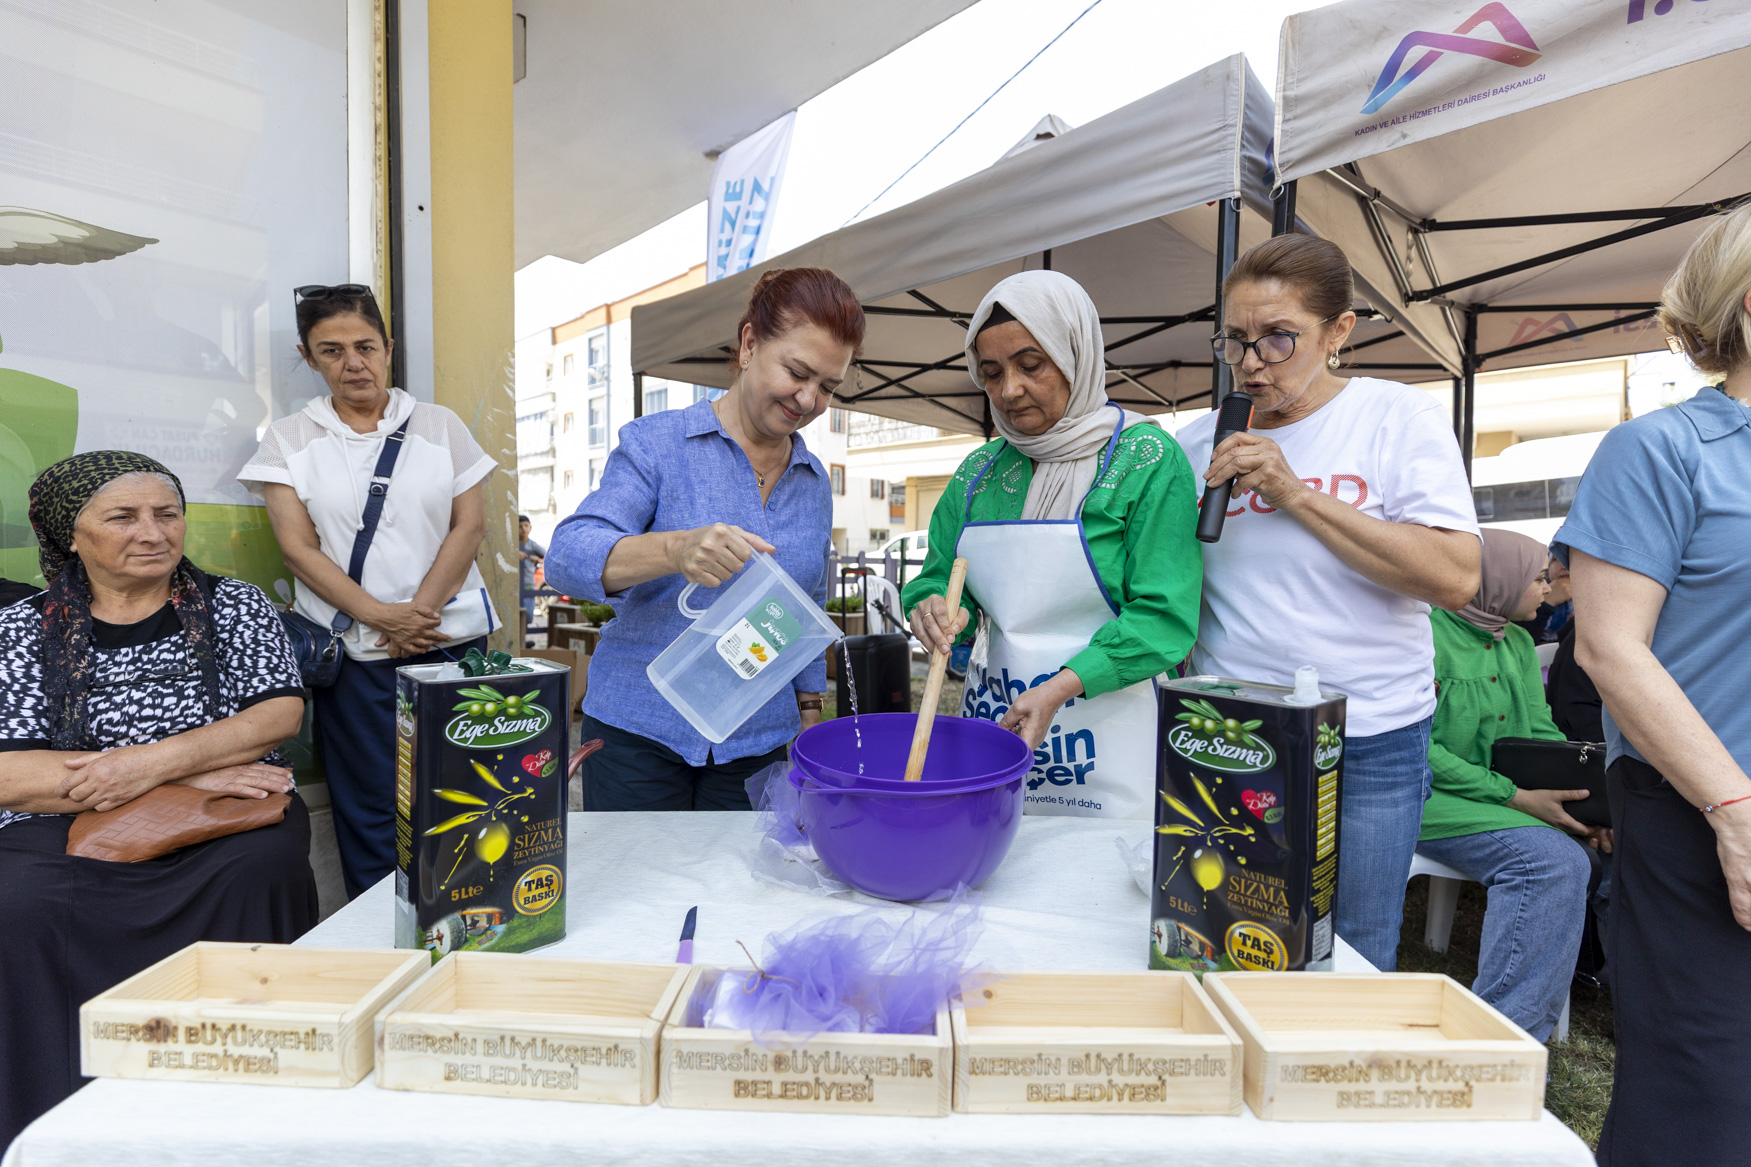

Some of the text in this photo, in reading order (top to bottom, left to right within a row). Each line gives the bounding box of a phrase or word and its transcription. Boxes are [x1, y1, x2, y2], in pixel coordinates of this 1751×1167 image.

[1354, 73, 1547, 137] KADIN VE AİLE HİZMETLERİ DAİRESİ BAŞKANLIĞI
[452, 716, 542, 746] Ege Sızma
[1174, 730, 1264, 767] Ege Sızma
[1058, 796, 1065, 805] 5
[1065, 797, 1076, 807] yıl
[1077, 799, 1102, 811] daha
[525, 817, 563, 833] NATUREL
[513, 840, 564, 860] ZEYTİNYAĞI
[514, 827, 563, 850] SIZMA
[524, 874, 554, 893] TAŞ
[1229, 875, 1291, 908] SIZMA
[1241, 868, 1289, 890] NATUREL
[450, 889, 460, 902] 5
[523, 889, 555, 906] BASKI
[1169, 895, 1178, 909] 5
[1227, 891, 1290, 918] ZEYTİNYAĞI
[1238, 931, 1275, 959] TAŞ
[1236, 948, 1277, 971] BASKI
[93, 1020, 335, 1053] MERSİN BÜYÜKŞEHİR
[148, 1049, 280, 1075] BELEDİYESİ
[388, 1032, 638, 1069] MERSİN BÜYÜKŞEHİR
[444, 1063, 580, 1091] BELEDİYESİ
[675, 1049, 934, 1080] MERSİN BÜYÜKŞEHİR
[968, 1053, 1227, 1081] MERSİN BÜYÜKŞEHİR
[1280, 1059, 1531, 1087] MERSİN BÜYÜKŞEHİR
[733, 1077, 875, 1103] BELEDİYESİ
[1026, 1079, 1168, 1103] BELEDİYESİ
[1336, 1085, 1475, 1110] BELEDİYESİ
